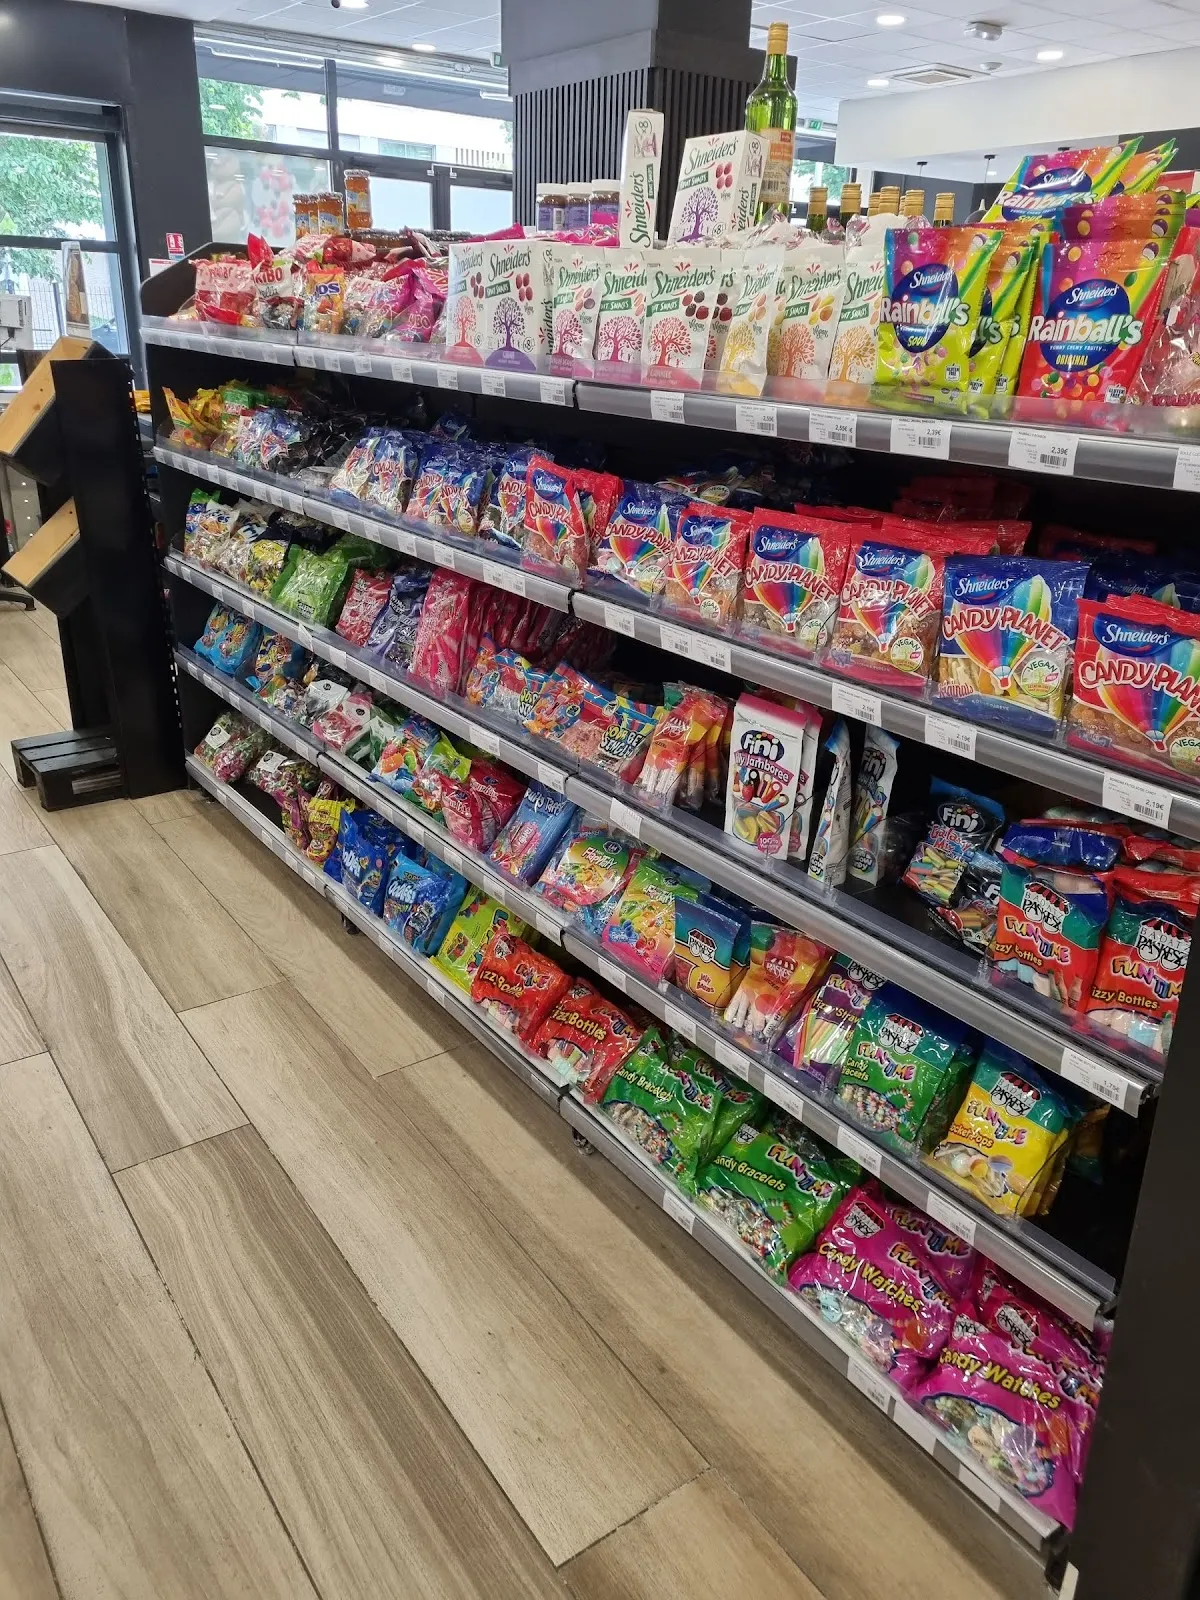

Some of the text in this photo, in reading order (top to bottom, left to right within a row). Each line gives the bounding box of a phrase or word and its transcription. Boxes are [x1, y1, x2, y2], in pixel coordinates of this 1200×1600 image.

[685, 136, 738, 175] Shneider's
[629, 171, 651, 248] Shneider's
[738, 187, 750, 231] neider's
[488, 247, 532, 282] Shneider's
[651, 266, 715, 299] Shneider's
[786, 266, 841, 303] Shneider's
[1066, 284, 1120, 305] Shneider's
[880, 294, 970, 326] Rainball's
[1028, 312, 1145, 346] Rainball's
[1056, 354, 1088, 366] ORIGINAL
[1051, 446, 1069, 456] 2,39€
[623, 504, 657, 516] Shneider's
[757, 537, 799, 552] Shneider's
[860, 553, 906, 568] Shneider's
[745, 563, 835, 602] CANDY PLANET
[955, 578, 1014, 597] Shneider's
[893, 580, 932, 619] PLANET
[942, 606, 1070, 651] CANDY PLANET
[1102, 623, 1170, 645] Shneider's
[896, 638, 920, 651] VEGAN
[1027, 659, 1058, 673] VEGAN
[1080, 659, 1200, 712] CANDY PLAN
[743, 733, 780, 761] Fini
[1176, 738, 1200, 749] VEGA
[746, 754, 789, 783] Jamboree
[943, 807, 979, 832] Fini
[1145, 799, 1164, 811] 2.19€
[1091, 986, 1160, 1011] izzy Bottles
[569, 1012, 608, 1042] Bottles
[846, 1058, 869, 1072] Candy
[714, 1155, 787, 1192] andy Bracelets
[819, 1242, 922, 1313] Candy Watches
[984, 1360, 1062, 1410] Watches
